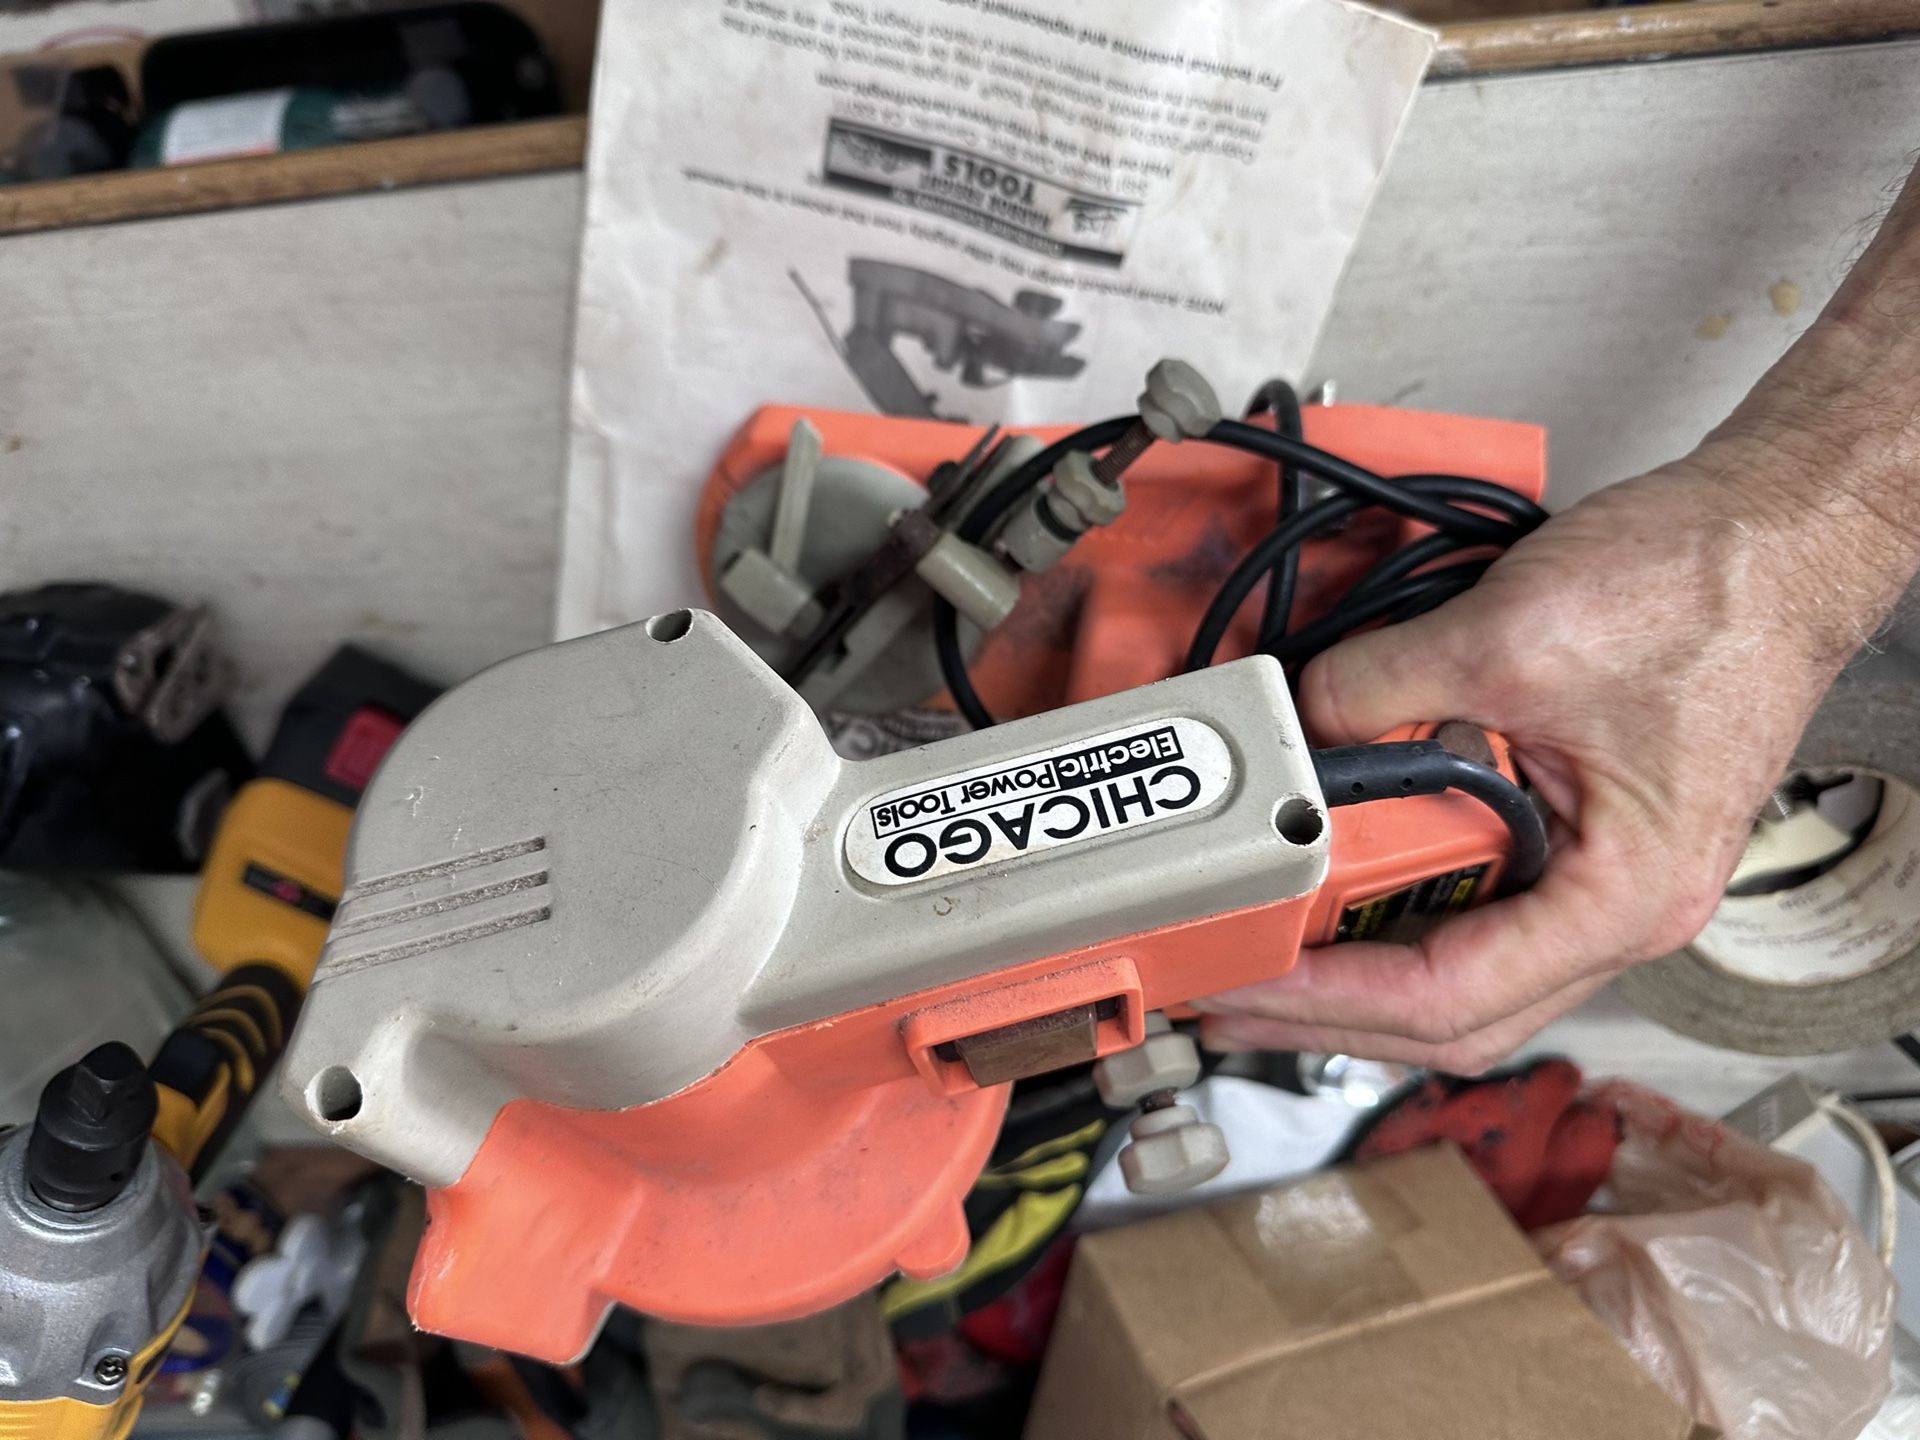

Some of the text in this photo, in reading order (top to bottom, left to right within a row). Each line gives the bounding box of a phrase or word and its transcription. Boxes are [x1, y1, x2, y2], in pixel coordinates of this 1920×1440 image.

[945, 156, 1034, 206] TOOLS
[876, 729, 1176, 832] Electric Power Tools
[884, 765, 1201, 878] CHICAGO
